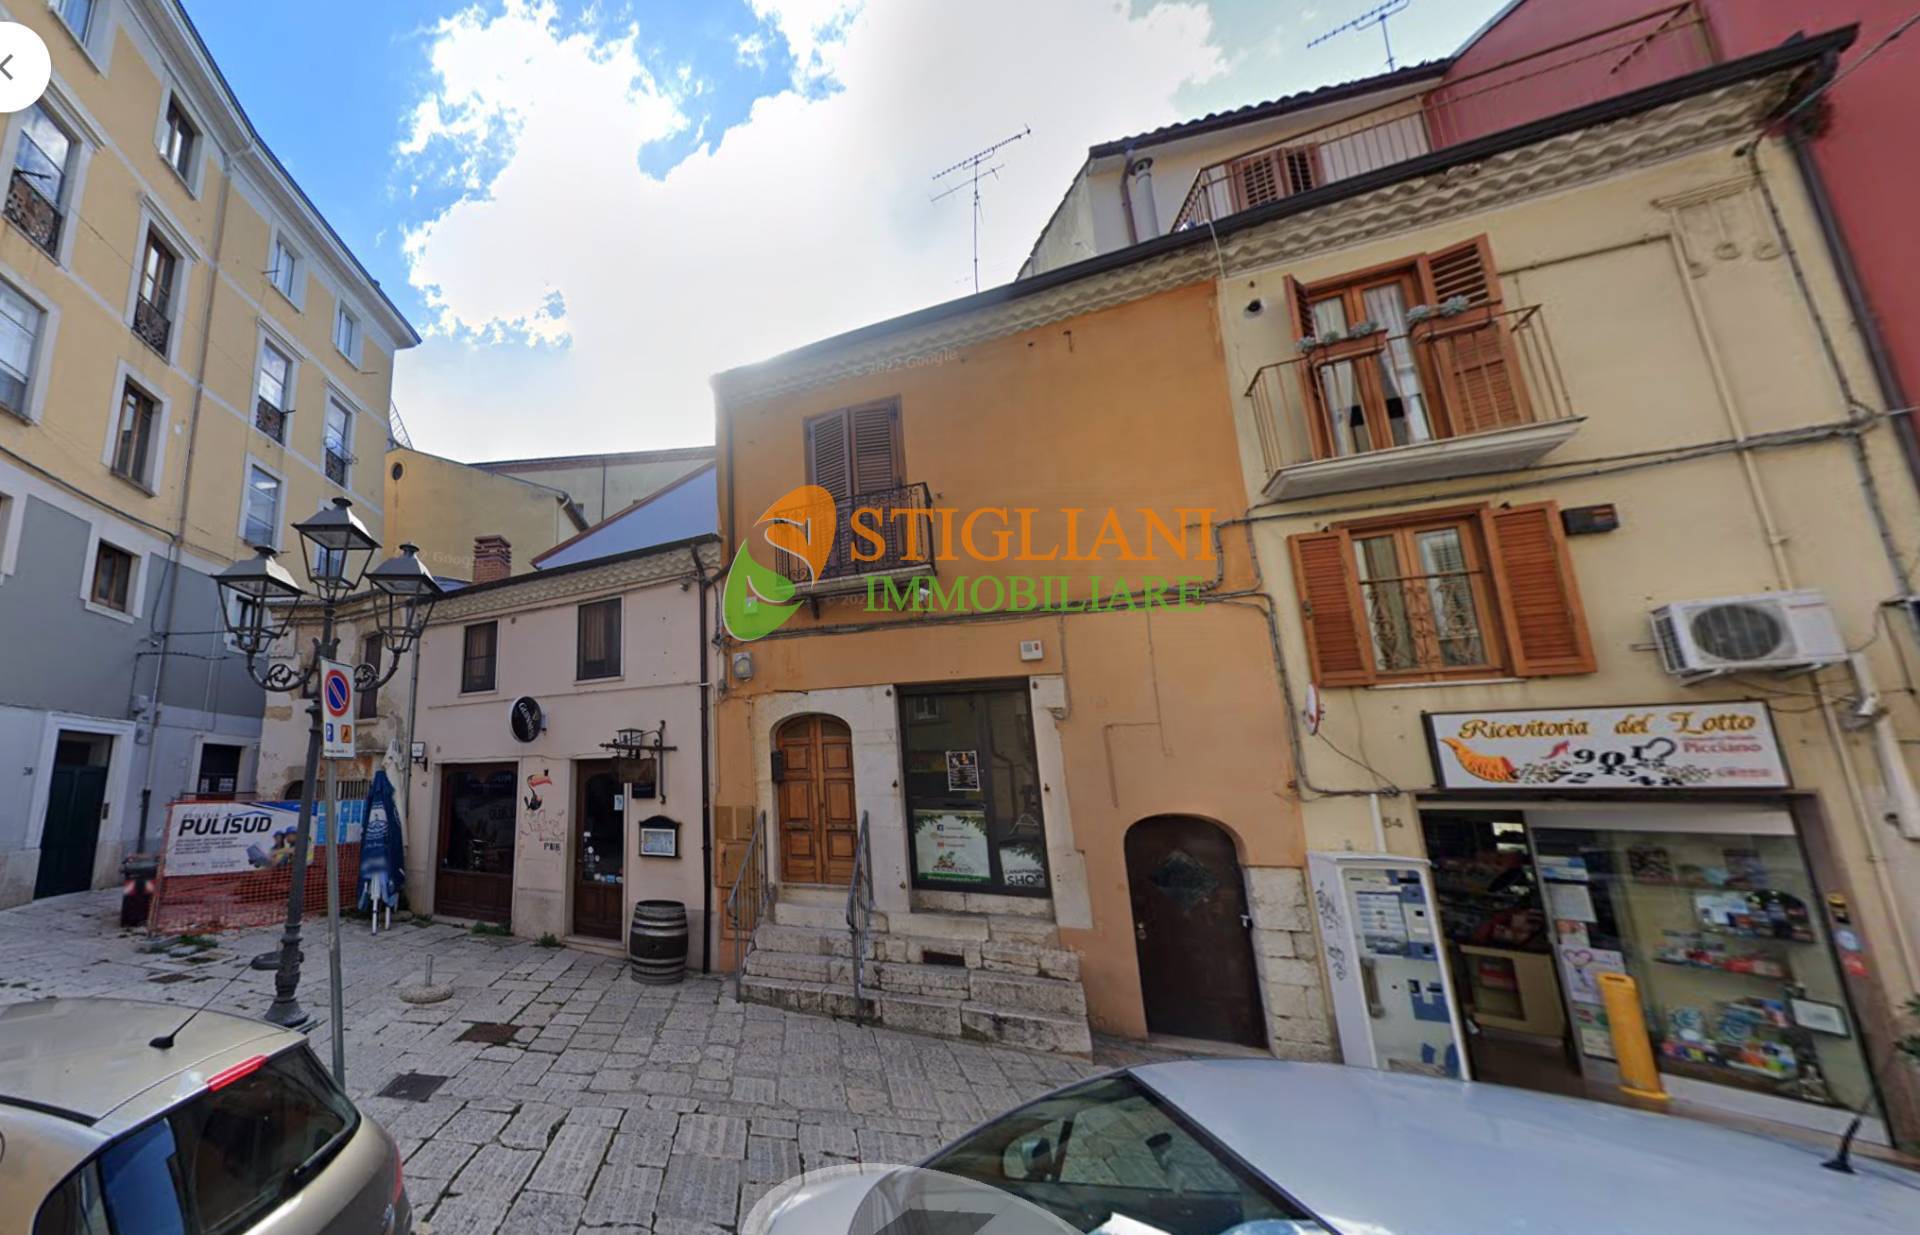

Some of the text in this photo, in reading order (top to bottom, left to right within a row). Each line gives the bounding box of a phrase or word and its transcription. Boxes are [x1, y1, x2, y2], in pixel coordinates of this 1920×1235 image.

[1458, 710, 1756, 741] Ricevitoria del Lotto
[178, 813, 273, 837] PULISUD
